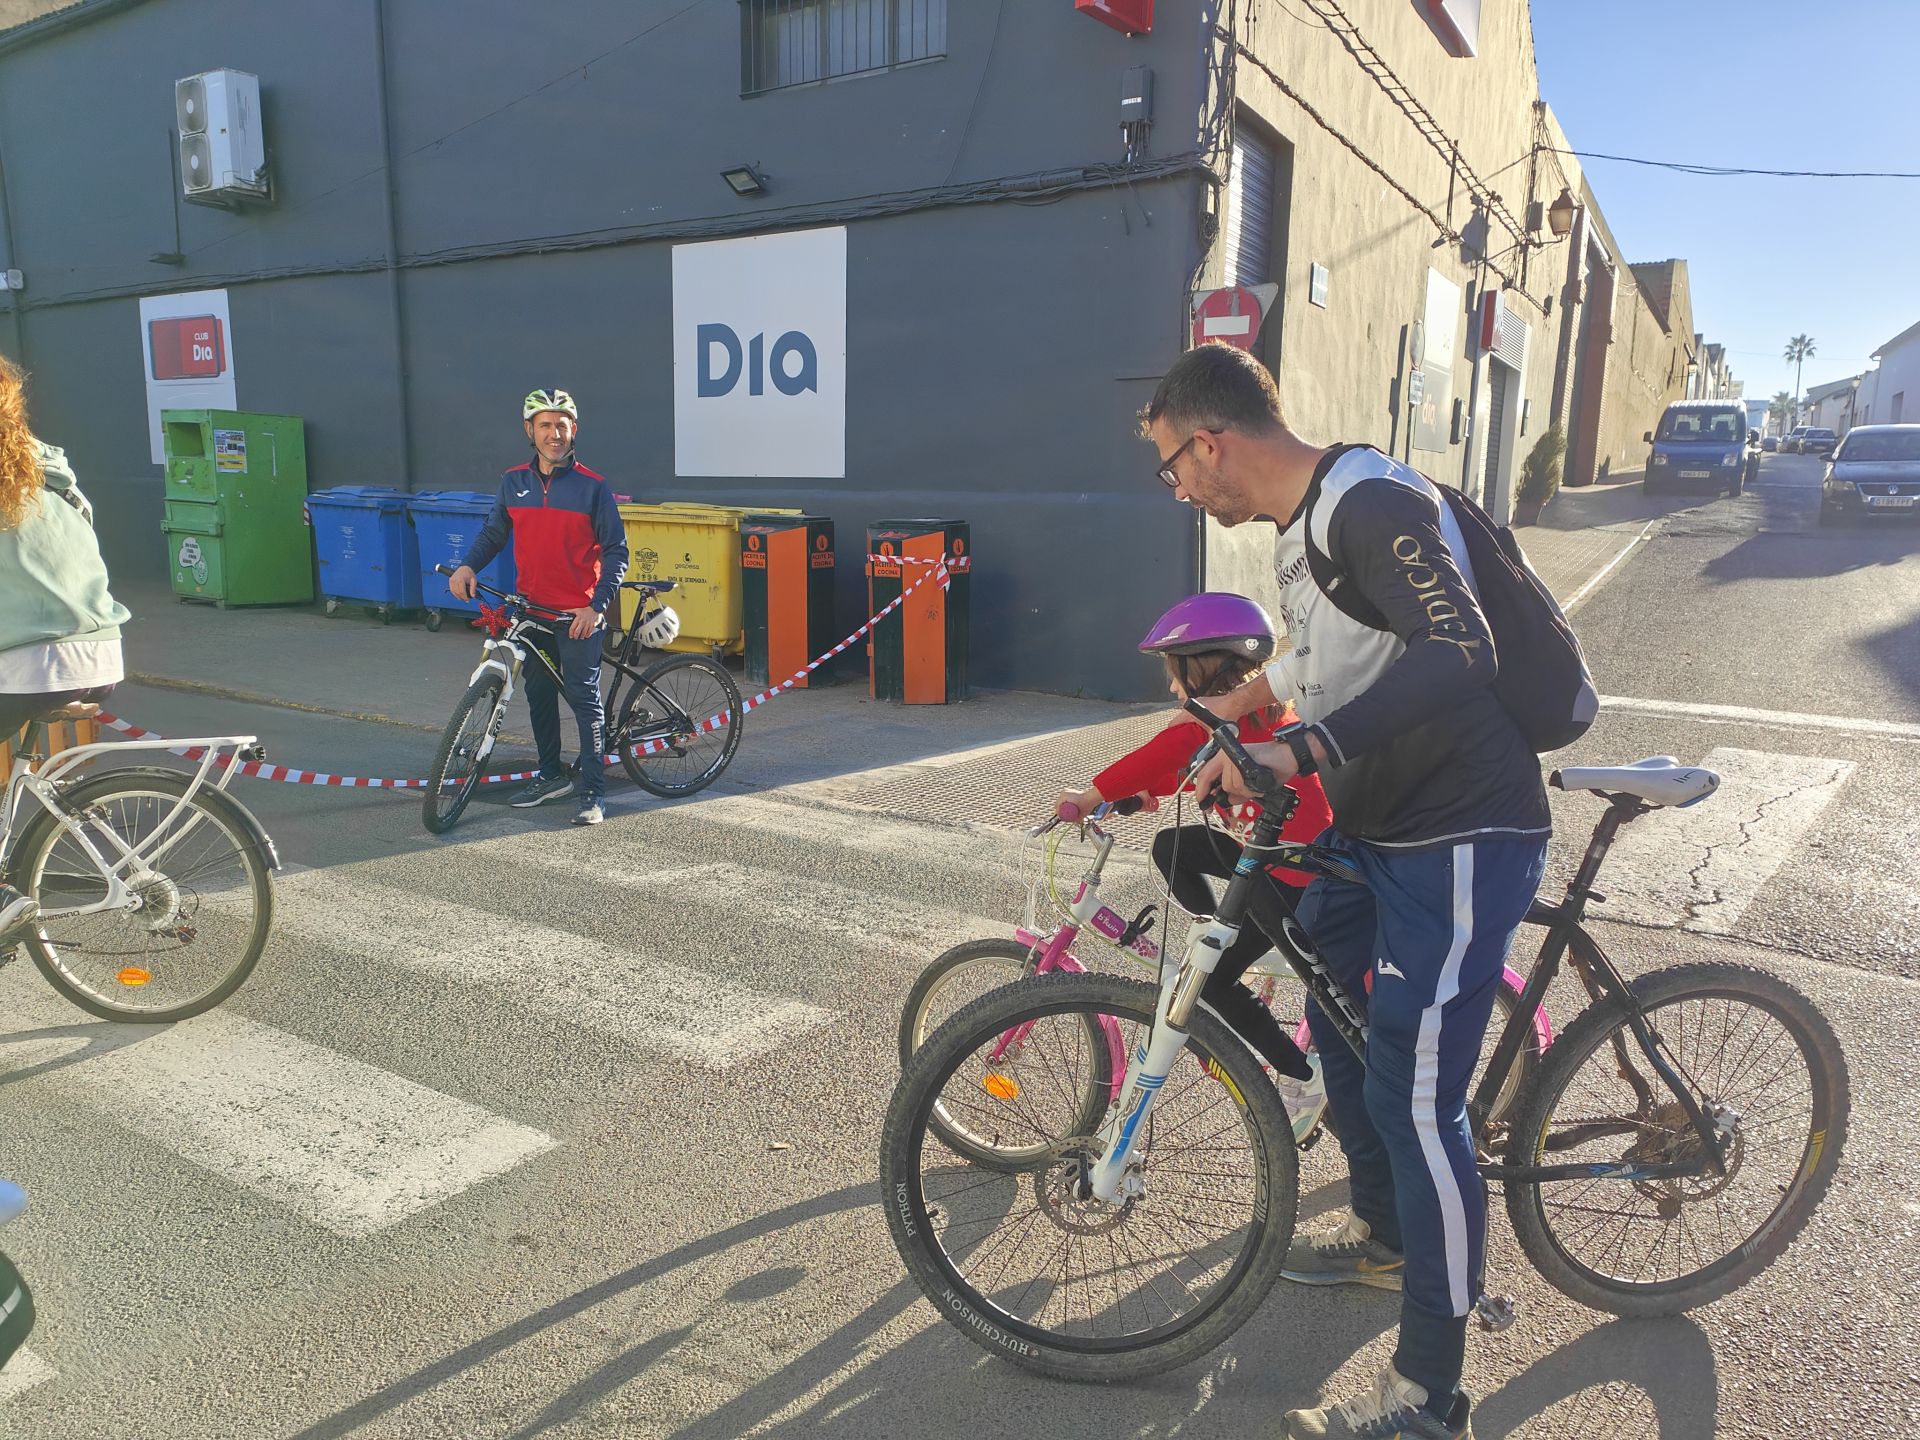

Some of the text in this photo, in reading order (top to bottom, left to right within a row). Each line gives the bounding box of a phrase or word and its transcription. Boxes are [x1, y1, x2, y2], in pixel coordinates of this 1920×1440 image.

[194, 332, 209, 341] CLUB
[896, 1183, 917, 1238] PYTHON
[942, 1289, 1030, 1355] HUTCHINSON
